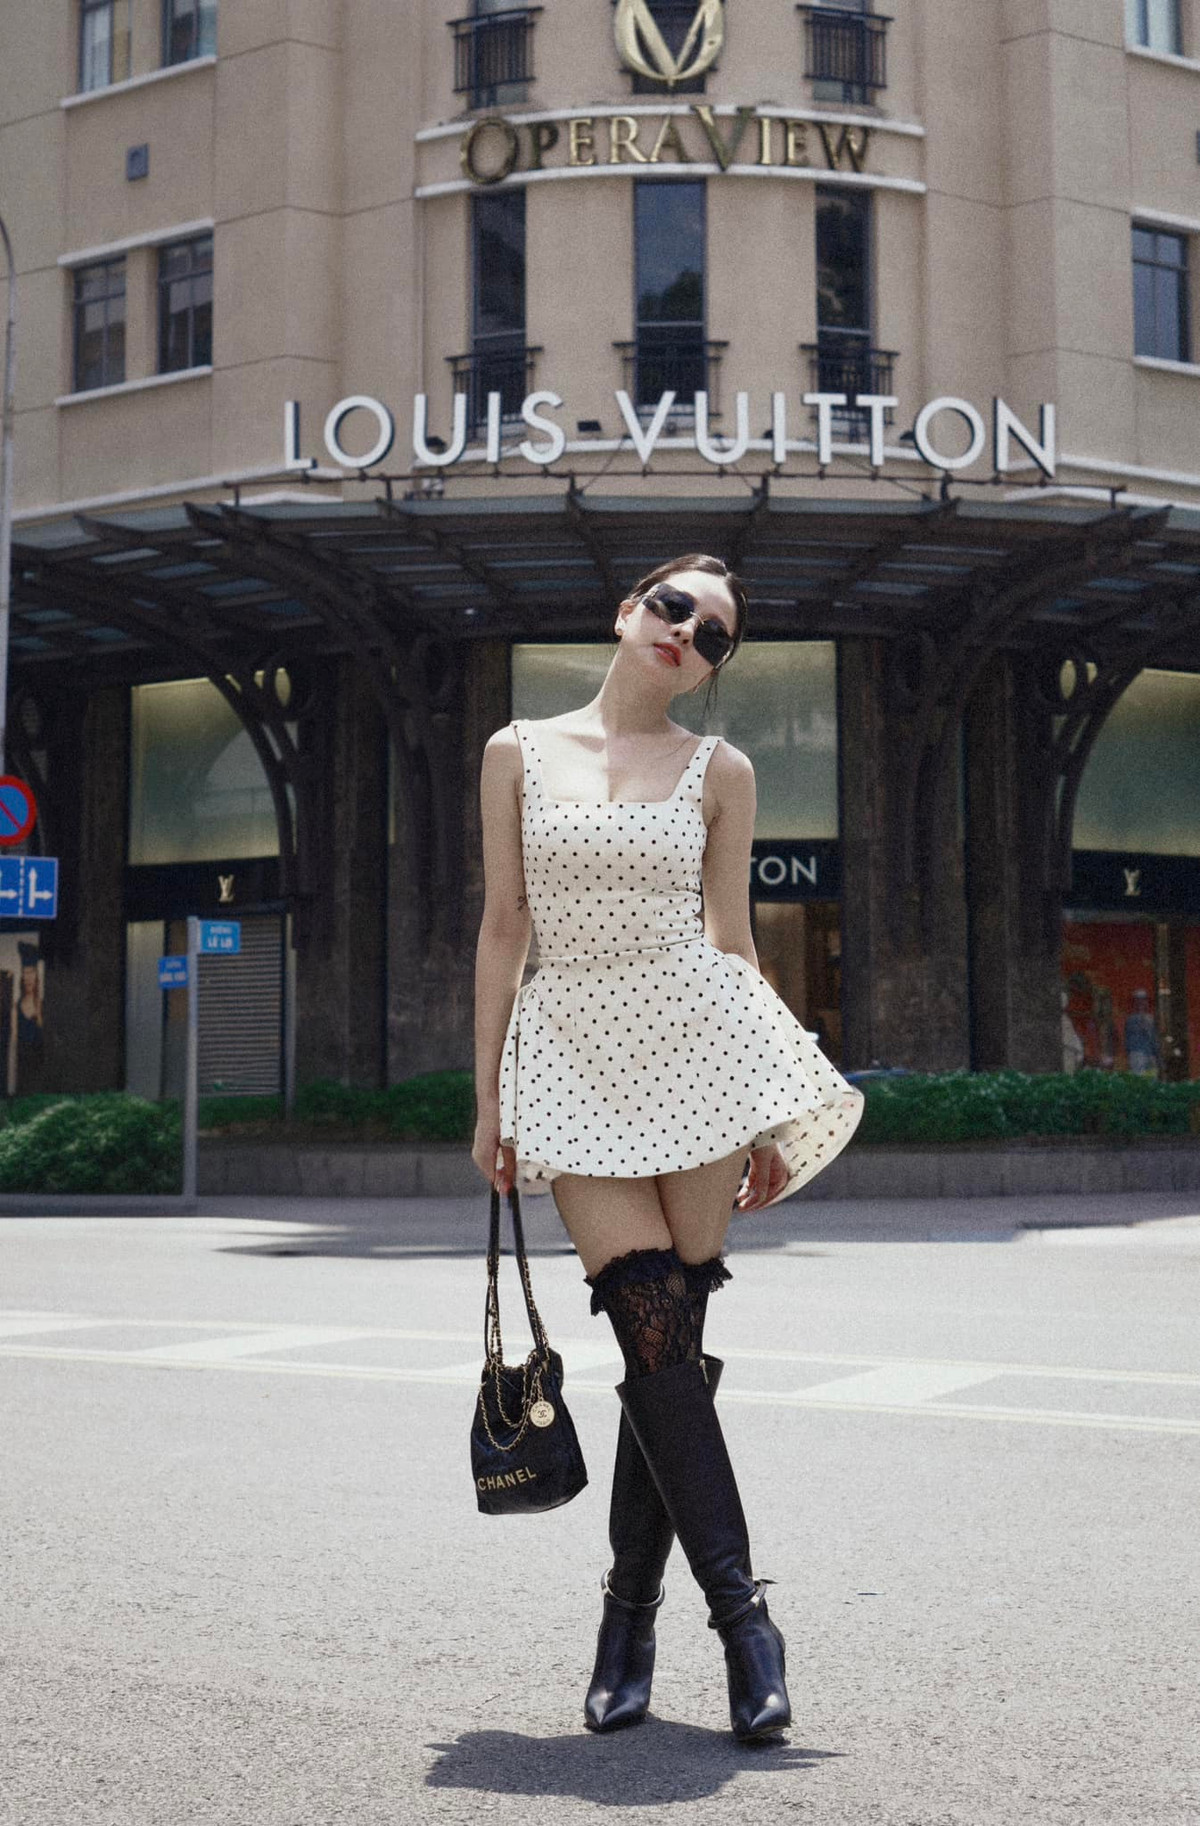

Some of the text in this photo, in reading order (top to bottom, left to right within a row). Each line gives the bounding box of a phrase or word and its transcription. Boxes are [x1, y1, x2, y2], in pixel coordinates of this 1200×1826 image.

[284, 390, 1056, 479] LOUIS VUITTON
[477, 1467, 536, 1490] CHANEL
